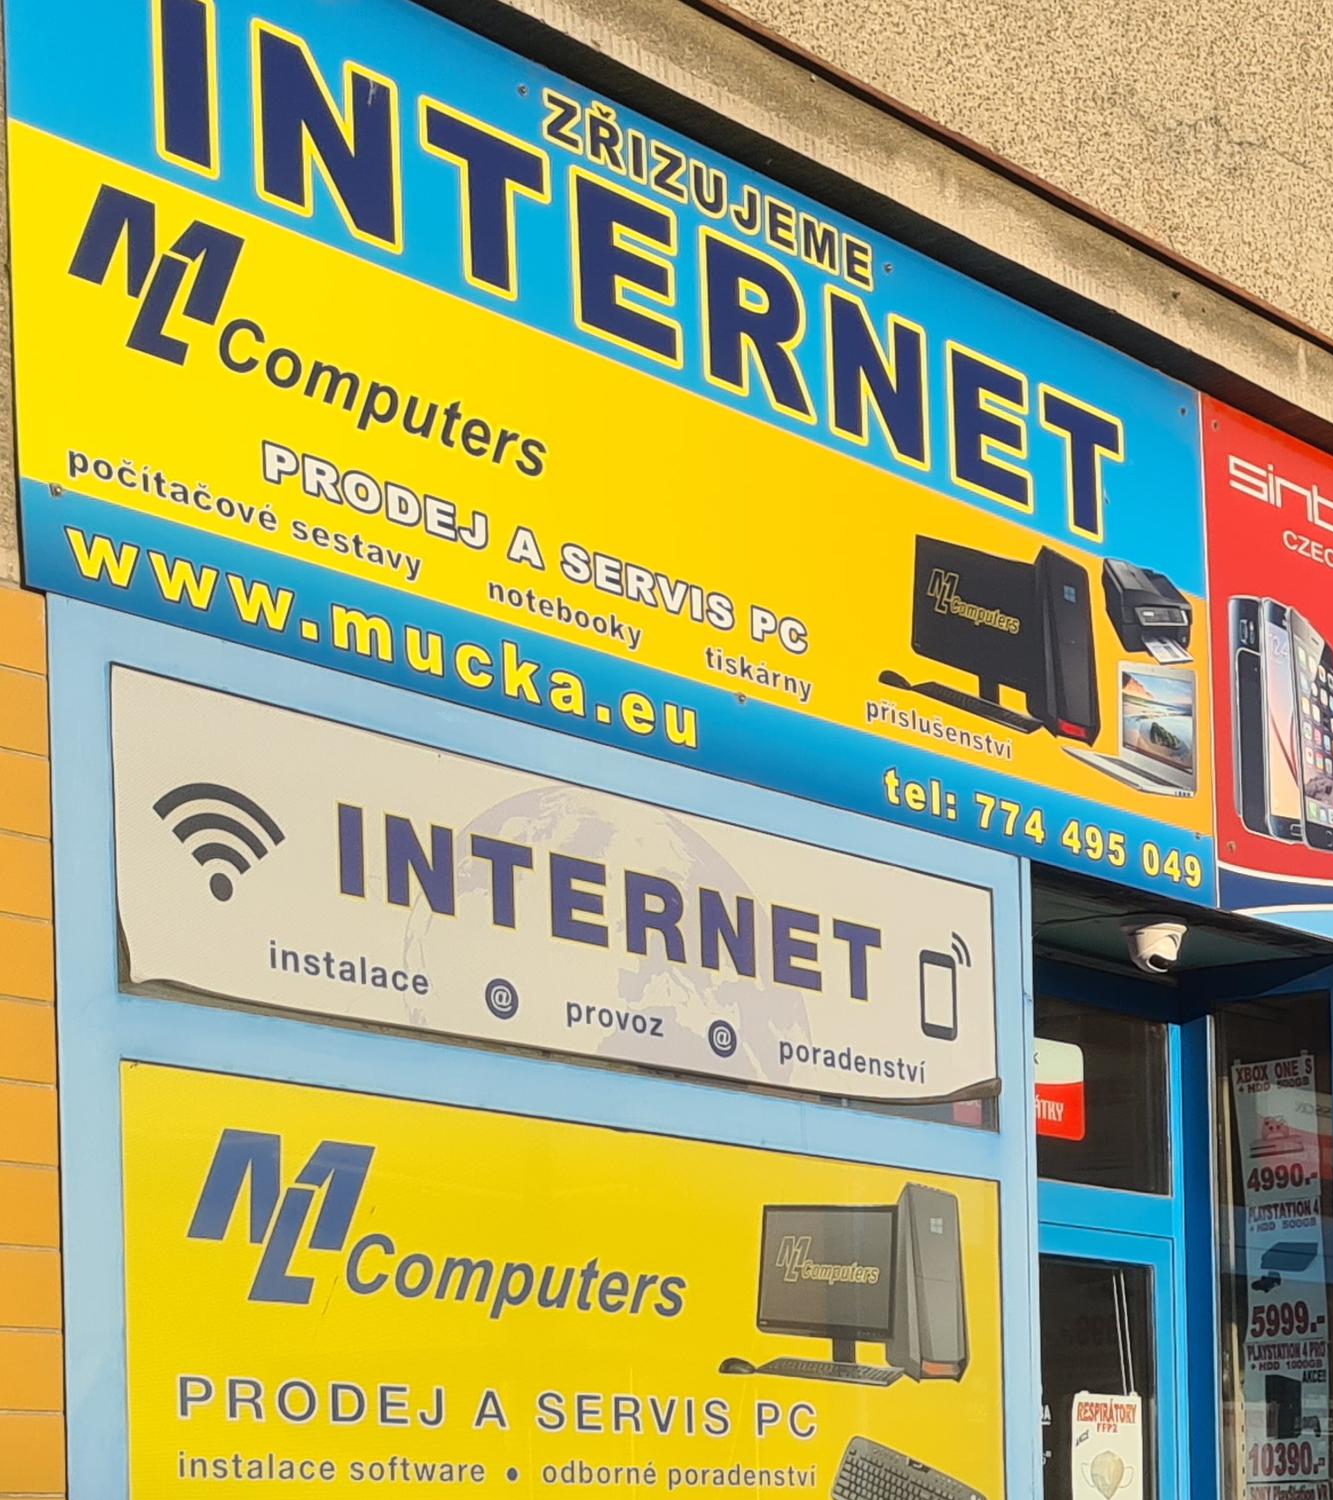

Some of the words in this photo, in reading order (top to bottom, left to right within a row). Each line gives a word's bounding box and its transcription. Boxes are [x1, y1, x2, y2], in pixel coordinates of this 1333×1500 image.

[541, 87, 872, 291] ZŘIZUJEME
[150, 0, 1124, 542] INTERNET
[217, 318, 548, 478] Computers
[67, 448, 279, 532] počítačové
[292, 519, 422, 582] sestavy
[261, 440, 489, 550] PRODEJ
[507, 527, 545, 570] A
[560, 543, 735, 632] SERVIS
[750, 605, 809, 653] PC
[64, 526, 698, 749] www.mucka.eu
[487, 579, 643, 650] notebooky
[950, 597, 1021, 634] Computers
[705, 645, 813, 702] tiskárny
[866, 700, 1014, 762] příslušenství
[884, 768, 957, 821] tel:
[975, 793, 1046, 846] 774
[1062, 821, 1126, 868] 495
[1143, 843, 1202, 888] 049
[335, 801, 883, 1004] INTERNET
[268, 938, 431, 997] instalace
[565, 1000, 666, 1038] provoz
[777, 1036, 928, 1085] poradenství
[1235, 1065, 1268, 1085] XBOX
[1275, 1061, 1301, 1080] ONE
[344, 1232, 688, 1320] Computers
[176, 1375, 447, 1428] PRODEJ
[474, 1390, 508, 1429] A
[537, 1390, 731, 1437] SERVIS
[756, 1400, 818, 1438] PC
[1076, 1397, 1137, 1424] RESPIRÁTORY
[1096, 1422, 1118, 1433] FFP2
[178, 1452, 337, 1481] instalace
[349, 1456, 486, 1484] software
[541, 1463, 657, 1490] odborné
[668, 1462, 817, 1491] poradenství
